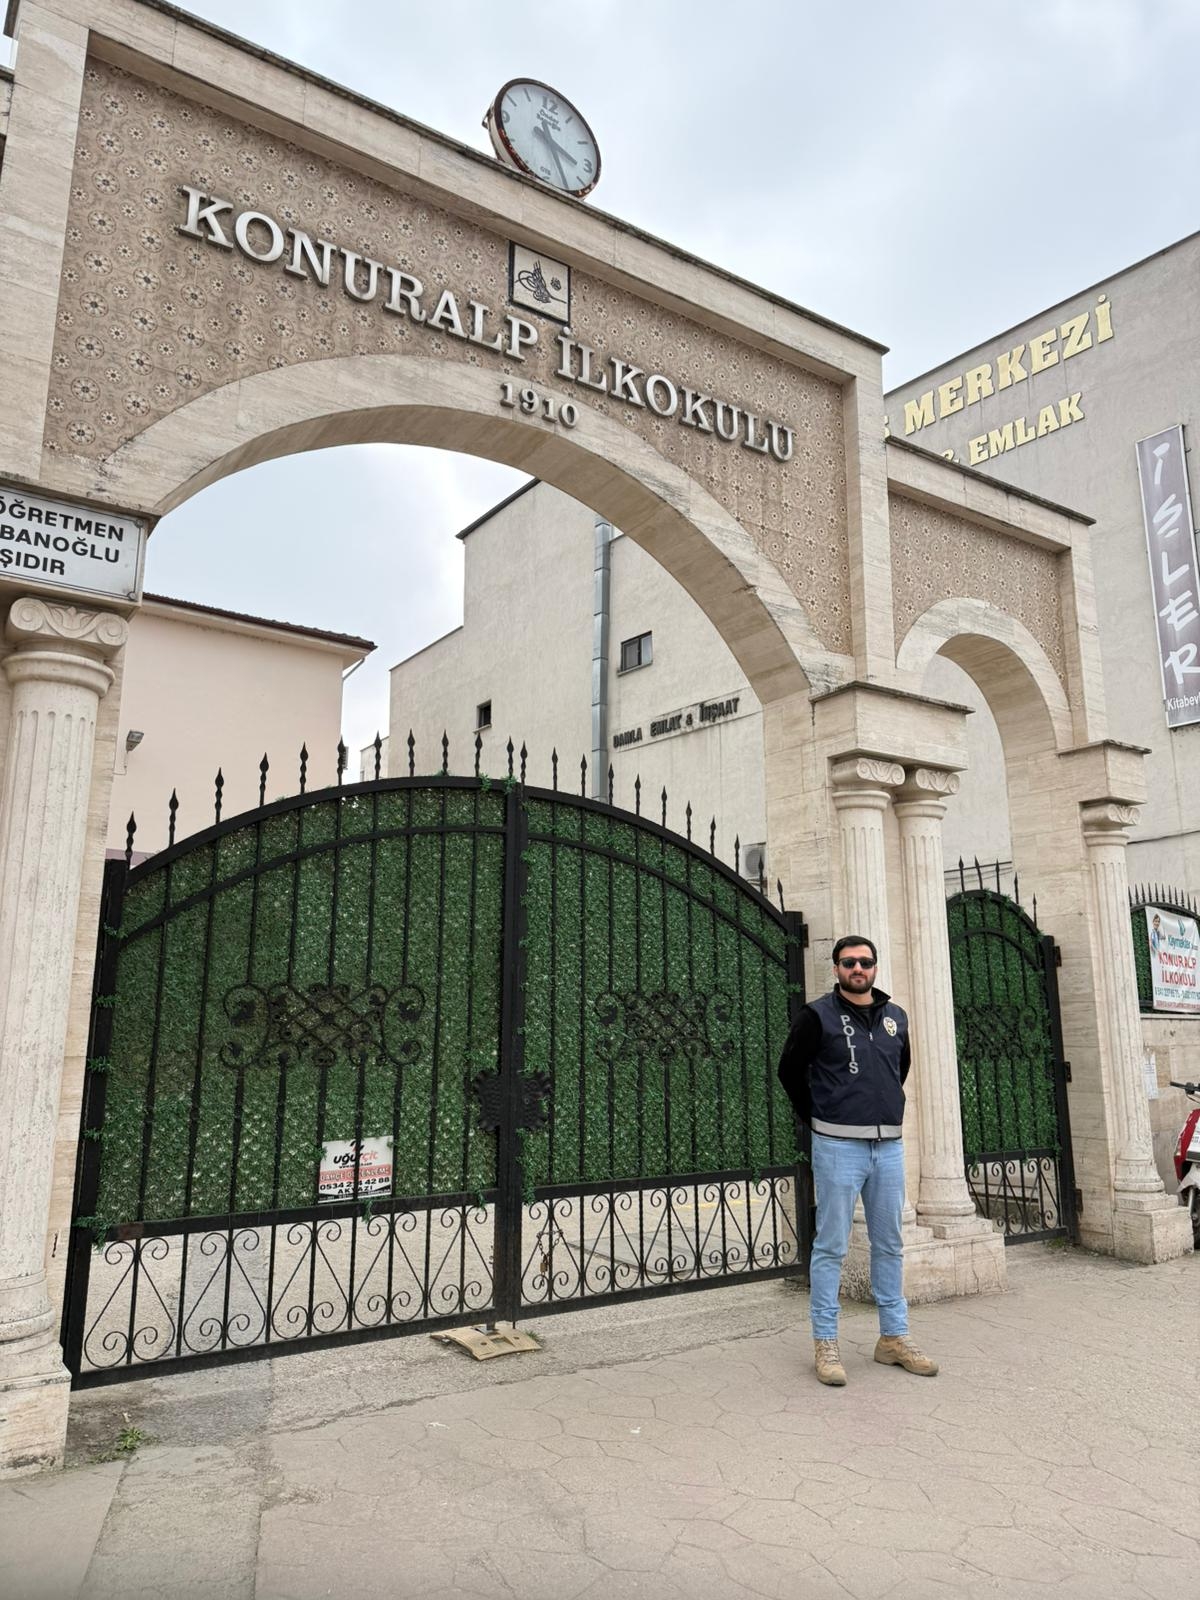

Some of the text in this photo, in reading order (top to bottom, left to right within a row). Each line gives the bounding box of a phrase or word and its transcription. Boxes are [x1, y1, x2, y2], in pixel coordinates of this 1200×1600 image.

[542, 96, 559, 116] 12
[583, 158, 593, 173] 3
[177, 184, 797, 463] KONURALP İLKOKULU
[903, 294, 1114, 436] MERKEZİ
[500, 382, 580, 429] 1910
[968, 391, 1085, 467] EMLAK
[0, 524, 119, 563] BANOĞLU
[0, 549, 65, 575] ŞIDIR
[1158, 951, 1197, 970] KONURALP
[1161, 966, 1197, 987] İLKOKULU
[319, 1182, 344, 1191] 0534
